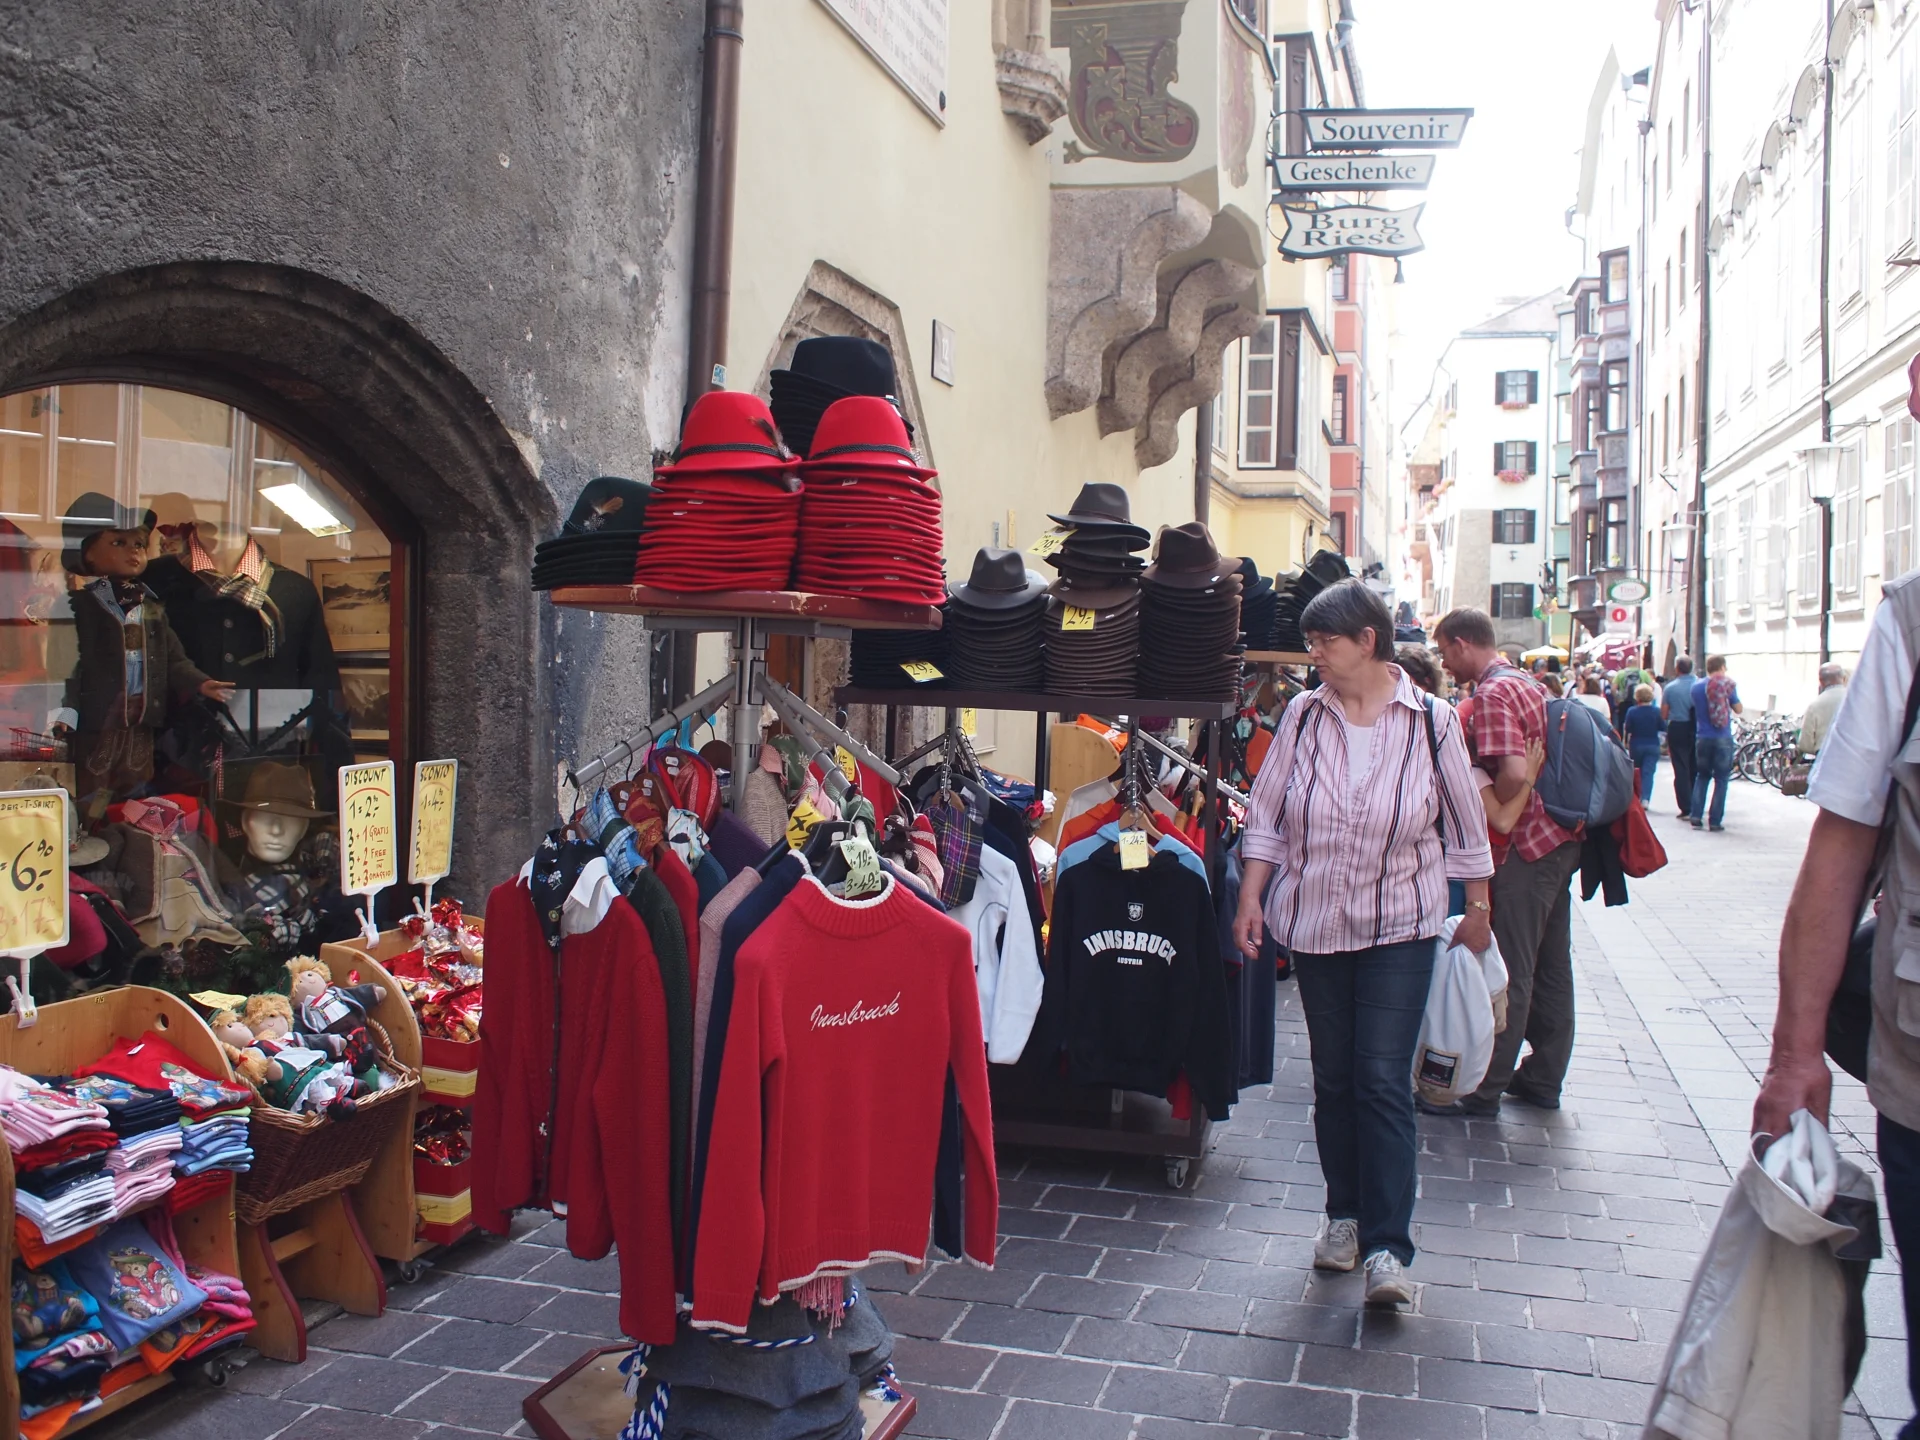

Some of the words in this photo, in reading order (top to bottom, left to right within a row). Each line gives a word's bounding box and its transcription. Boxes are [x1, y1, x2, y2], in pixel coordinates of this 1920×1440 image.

[1322, 117, 1449, 141] Souvenir
[1290, 161, 1416, 181] Geschenke
[1310, 213, 1401, 234] Burg
[1302, 230, 1405, 247] Riese
[344, 768, 387, 786] DISCOUNT
[1083, 929, 1178, 966] INNSBRUCK
[1117, 957, 1143, 966] AUSTRIA
[810, 991, 901, 1031] Innsbruck
